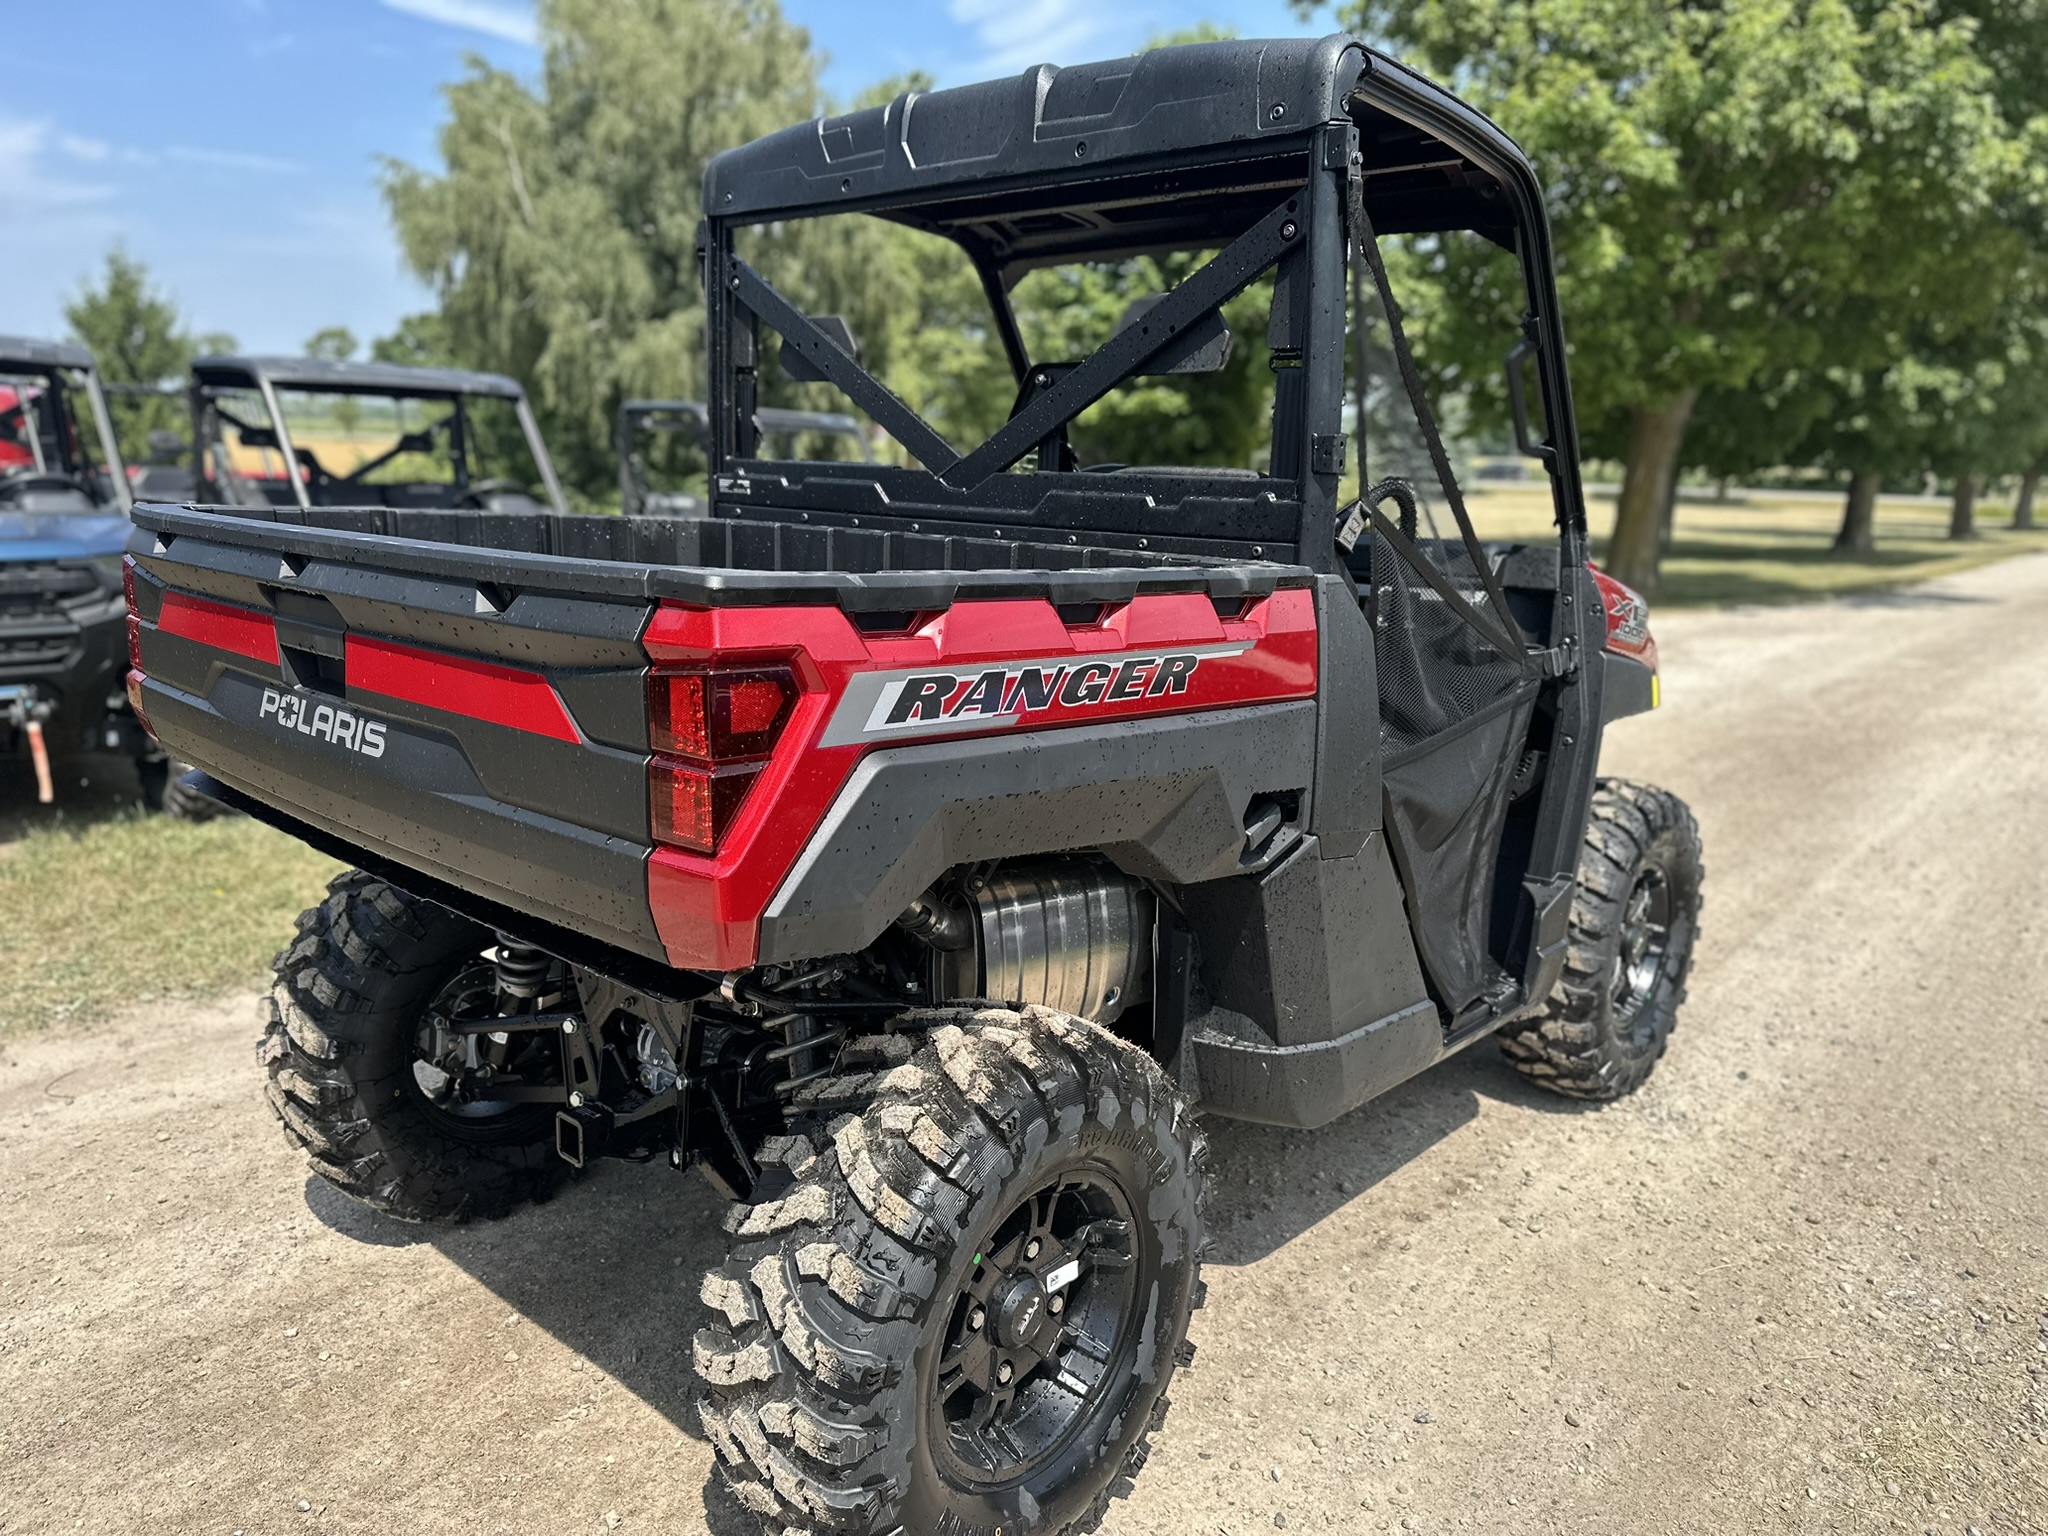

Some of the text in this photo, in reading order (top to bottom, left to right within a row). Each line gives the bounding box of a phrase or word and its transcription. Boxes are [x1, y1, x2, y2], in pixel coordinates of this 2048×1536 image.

[1608, 593, 1649, 624] XP
[259, 687, 387, 758] POLARIS
[884, 654, 1198, 725] RANGER
